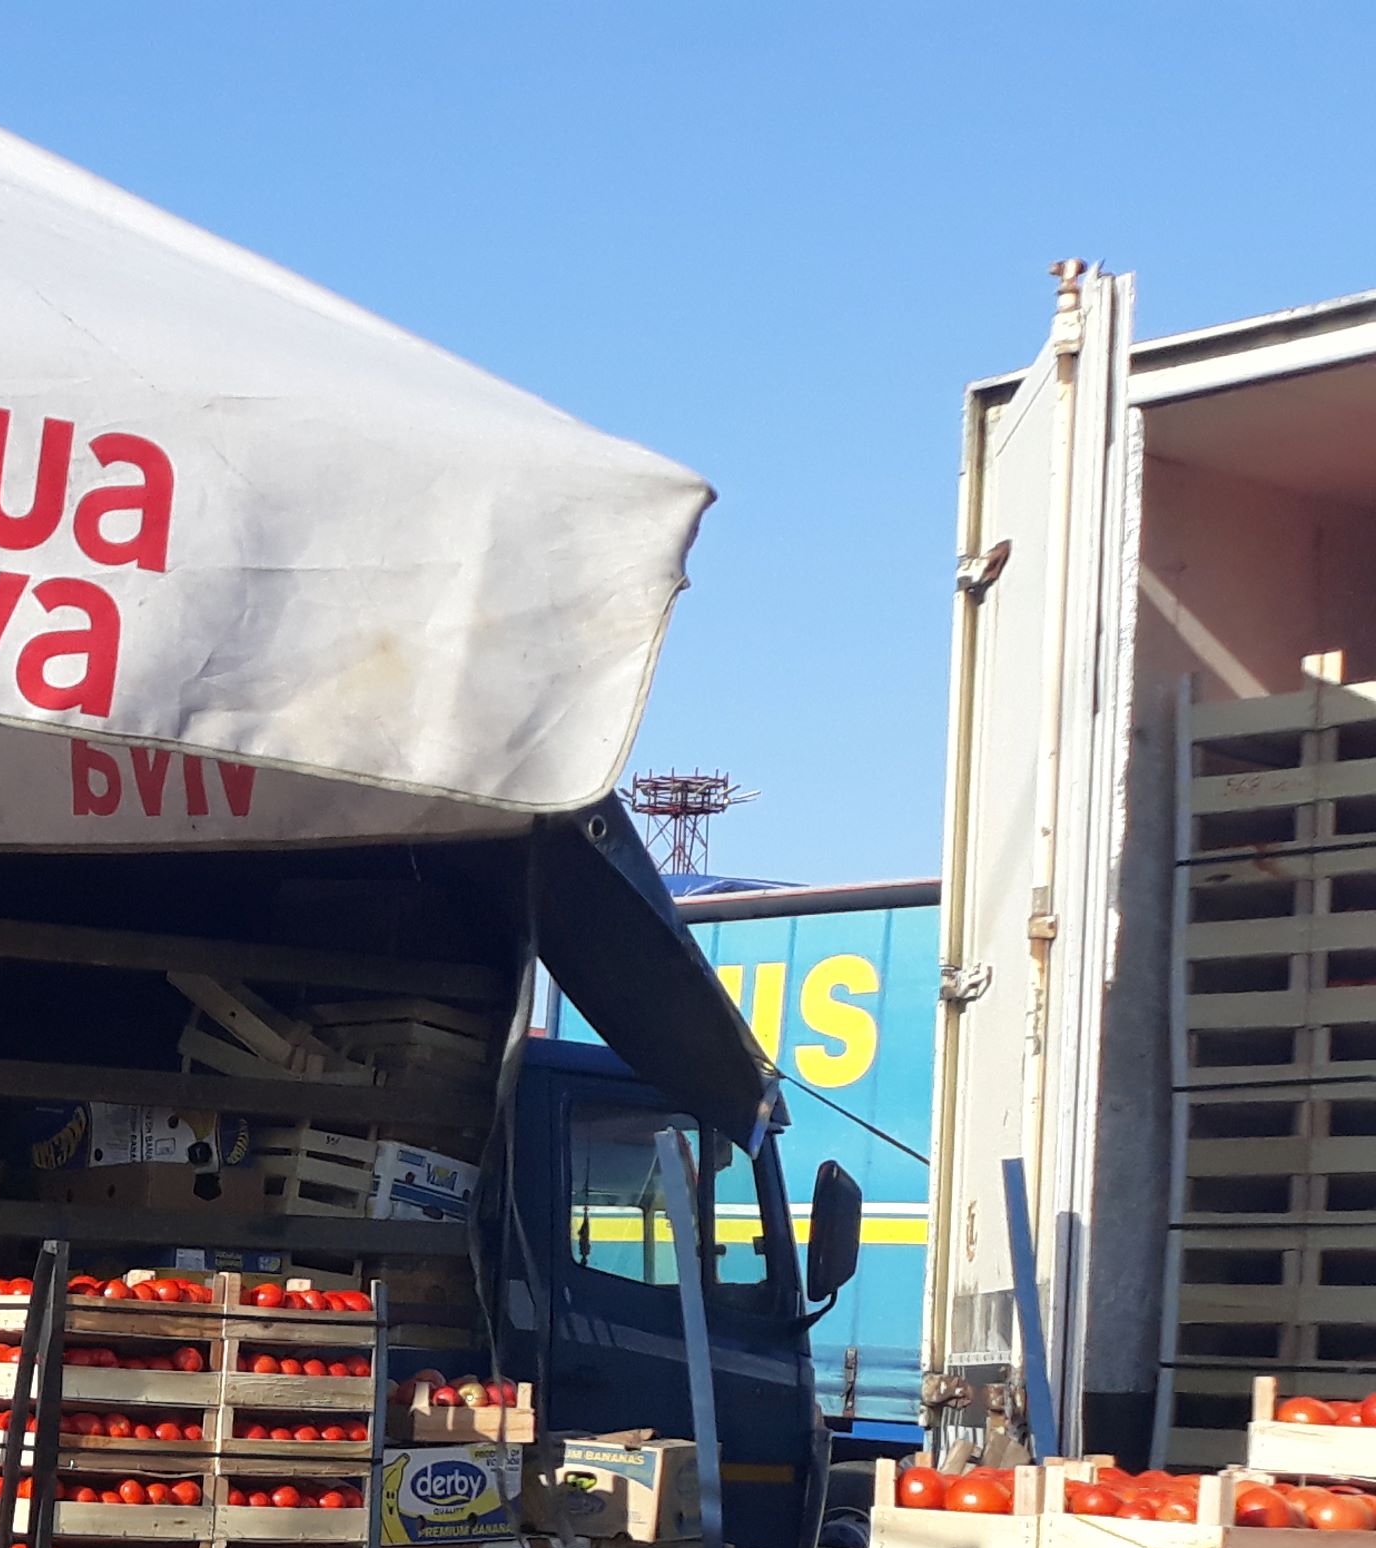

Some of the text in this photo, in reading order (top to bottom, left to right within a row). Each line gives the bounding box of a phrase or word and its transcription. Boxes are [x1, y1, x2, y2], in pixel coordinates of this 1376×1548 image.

[584, 1450, 646, 1465] BANANAS
[415, 1464, 482, 1501] derby
[418, 1525, 470, 1538] PREMIUM
